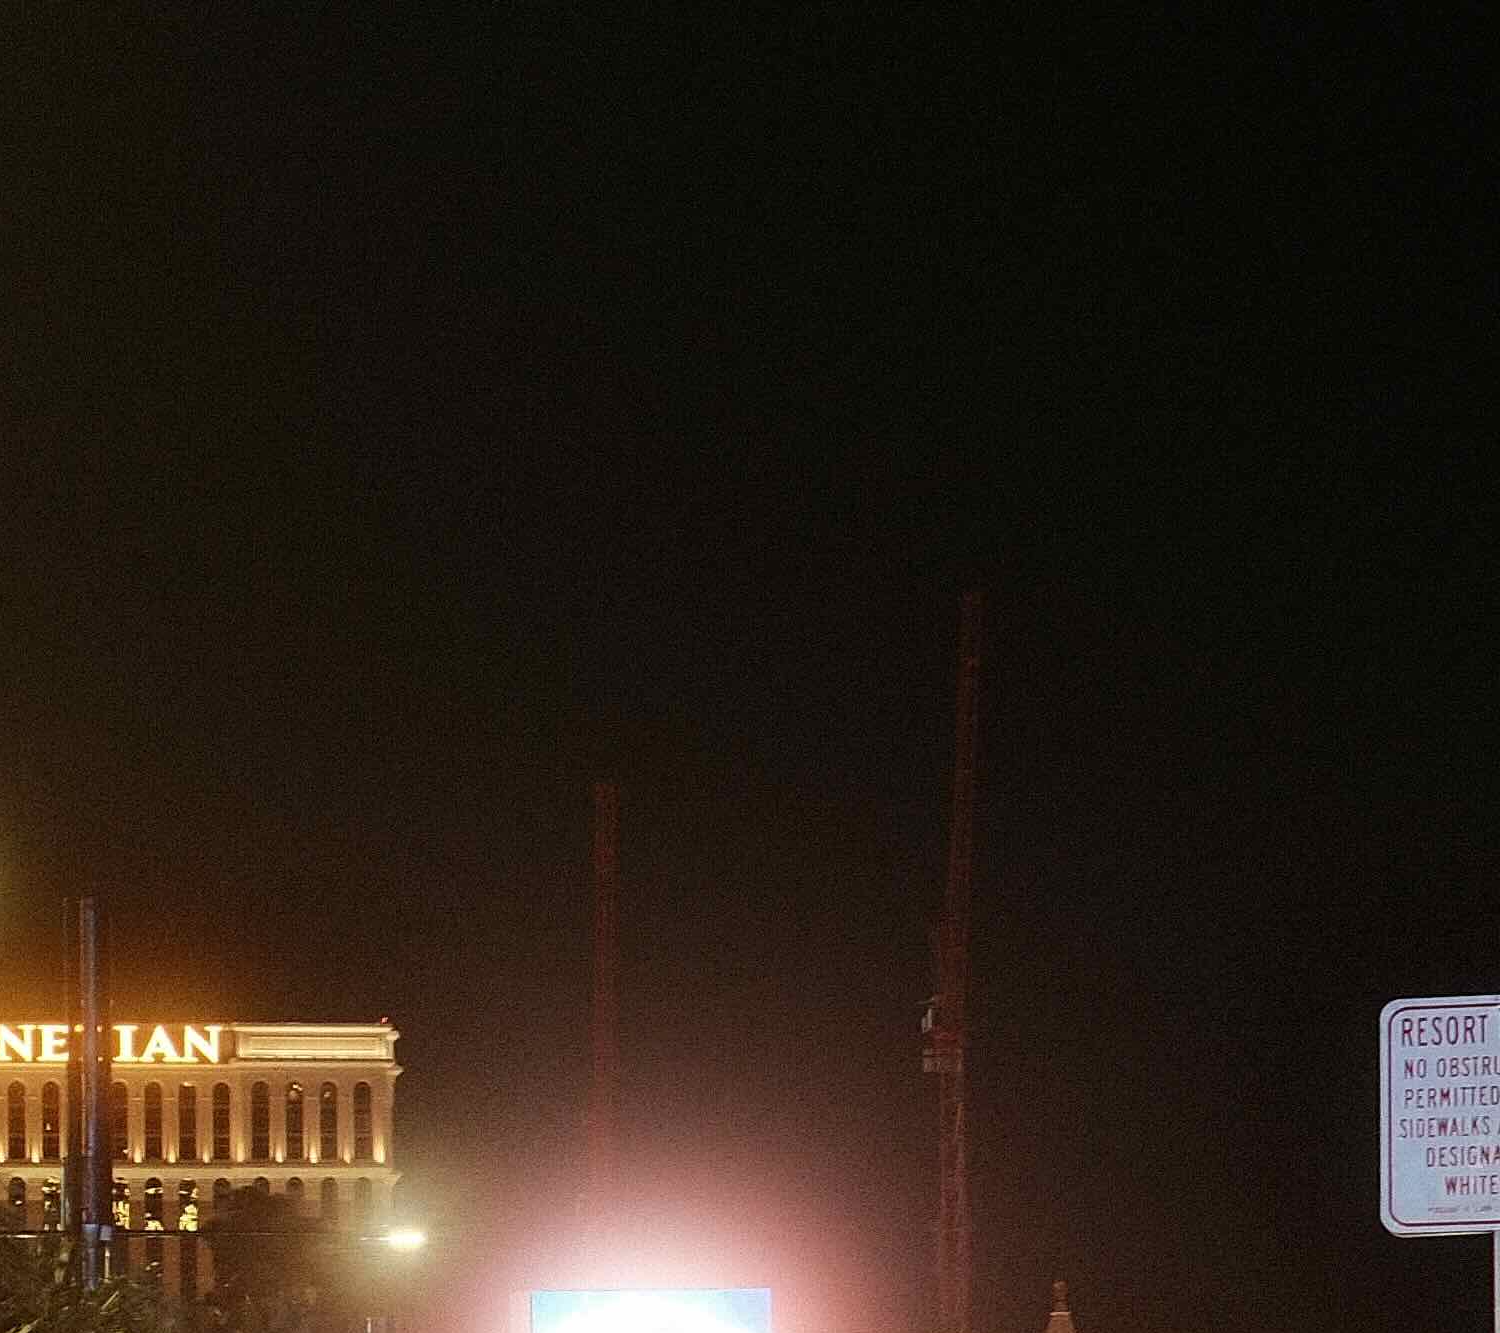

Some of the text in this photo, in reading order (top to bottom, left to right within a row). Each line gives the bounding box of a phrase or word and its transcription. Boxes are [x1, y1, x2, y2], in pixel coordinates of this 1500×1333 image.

[1402, 1014, 1488, 1047] RESORT
[1404, 1058, 1427, 1079] NO
[1403, 1085, 1500, 1109] PERMITTED
[1399, 1115, 1491, 1138] SIDEWALKS
[1444, 1174, 1499, 1195] WHITE
